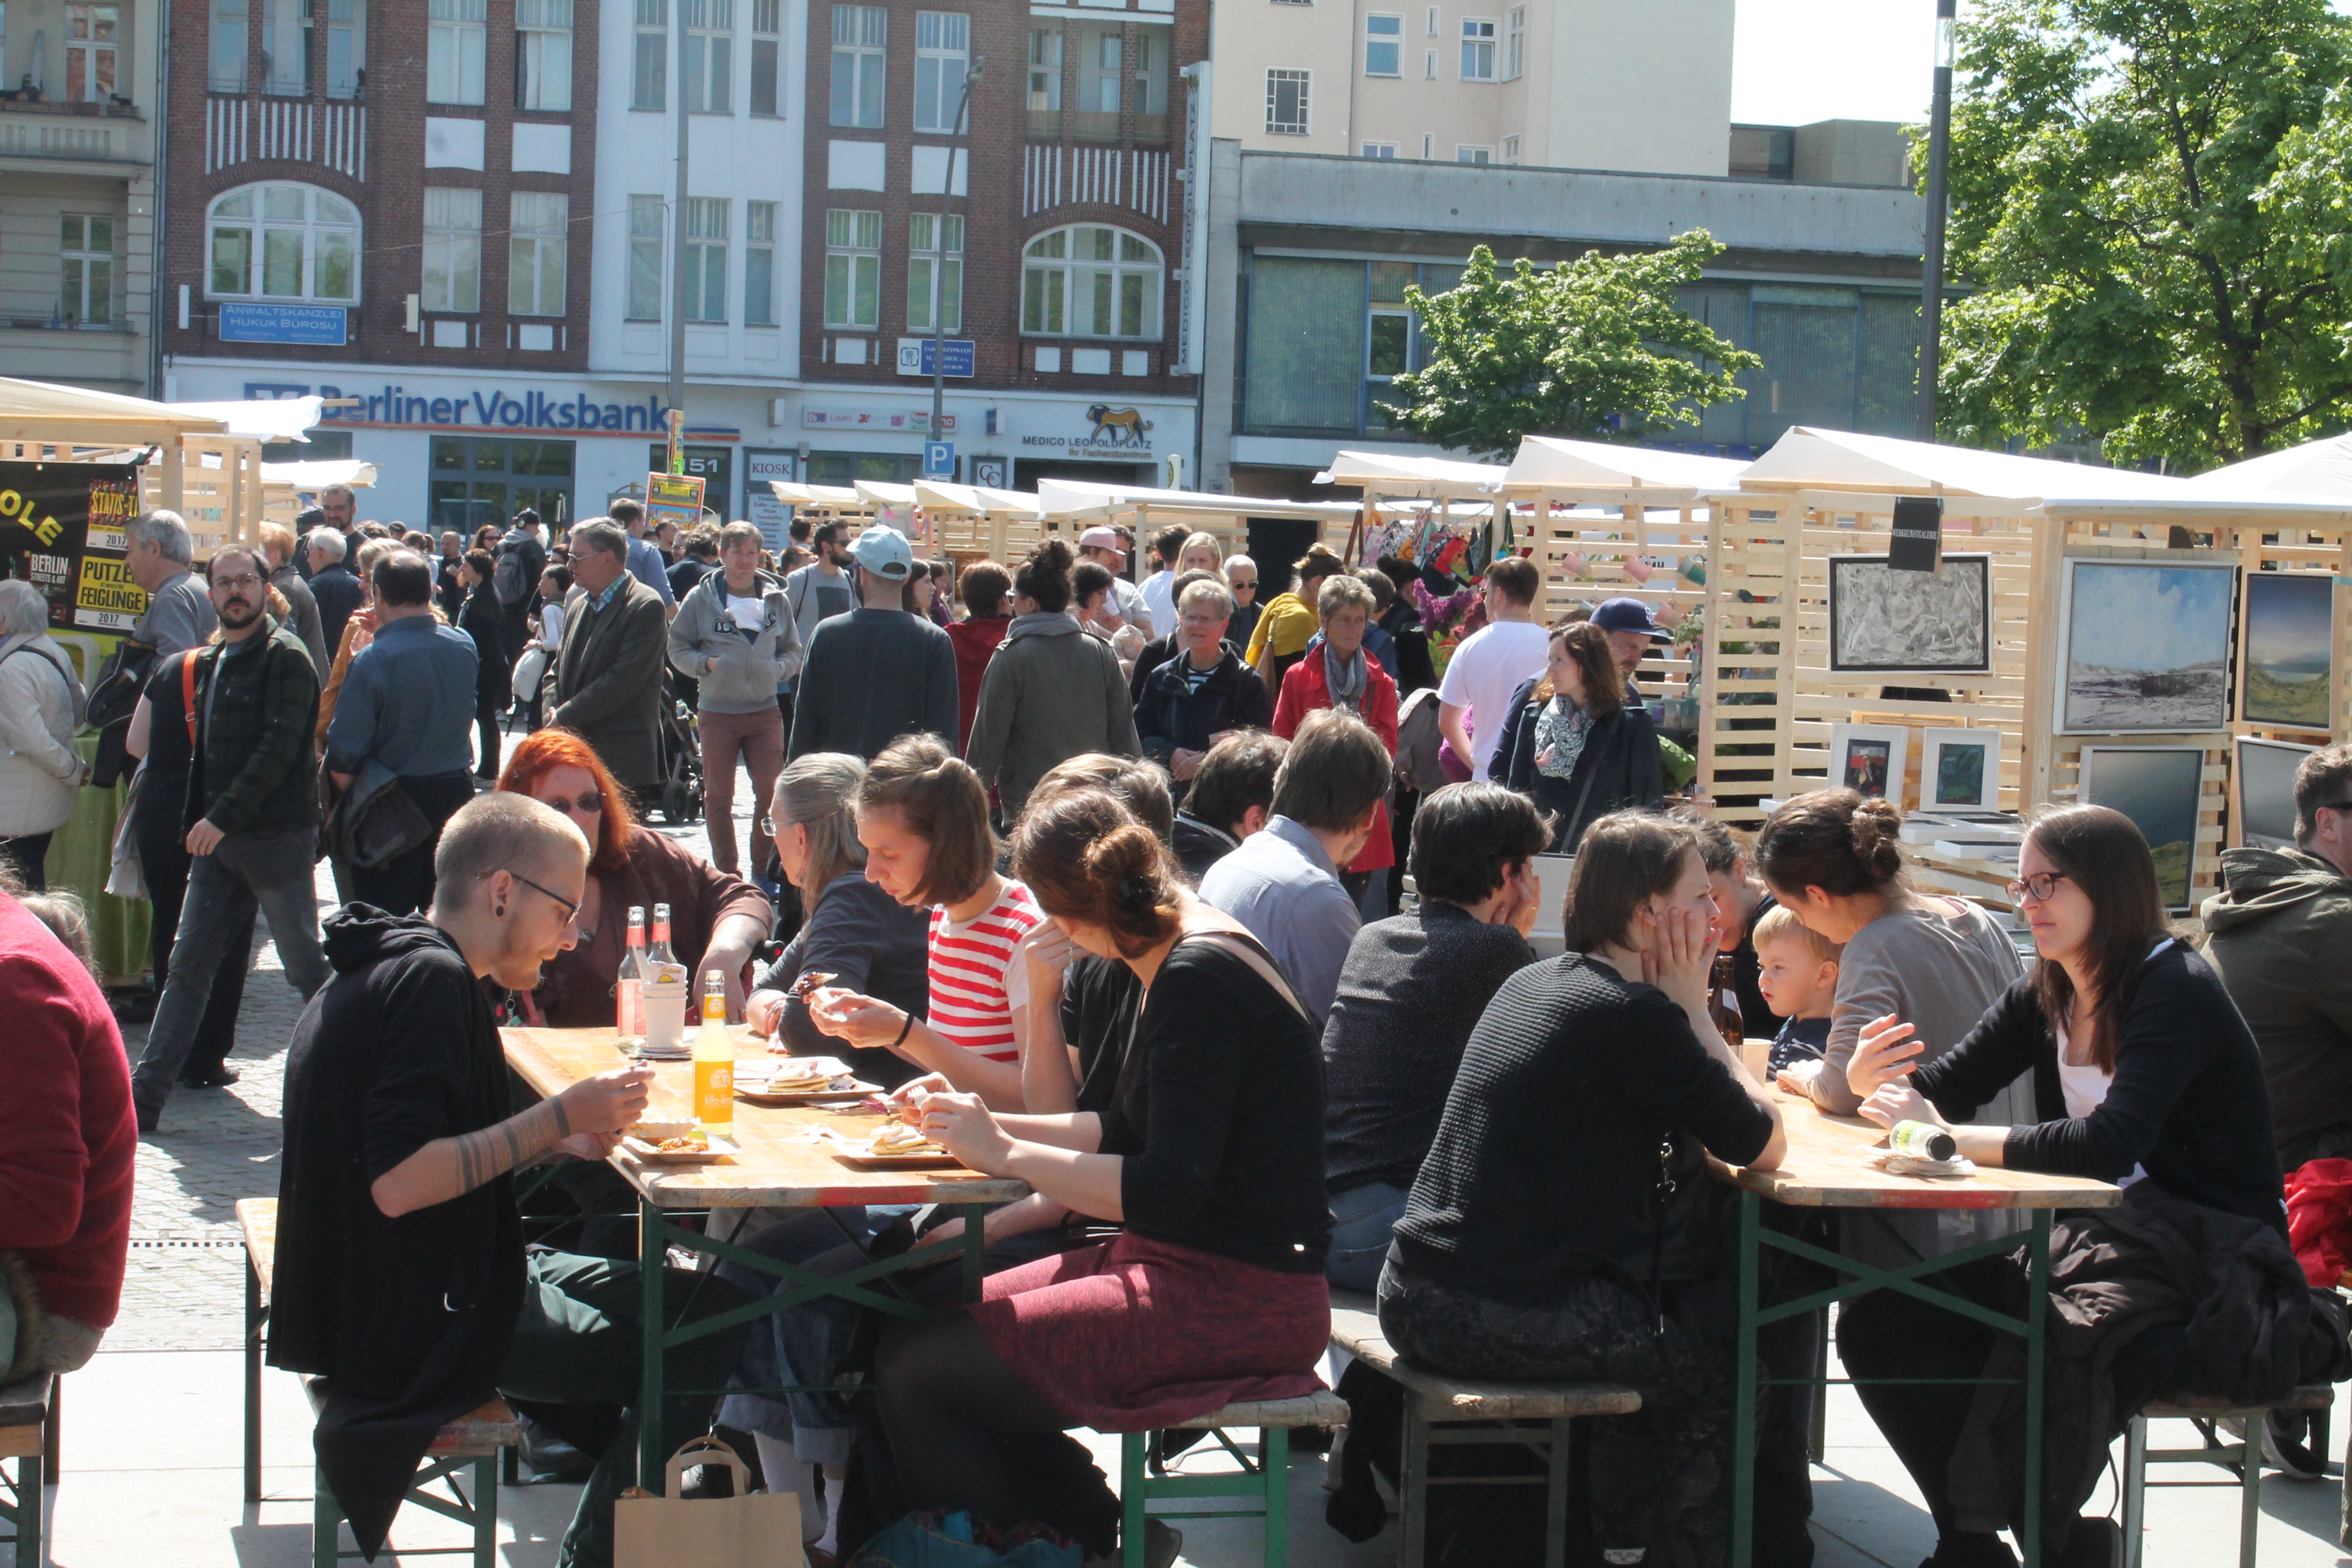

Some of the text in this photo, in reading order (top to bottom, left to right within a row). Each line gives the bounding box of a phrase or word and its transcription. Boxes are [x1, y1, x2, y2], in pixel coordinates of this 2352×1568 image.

[1185, 103, 1196, 270] LEOPOLDPLATZ
[225, 306, 341, 318] ANWALTSKANZLEI
[230, 318, 277, 328] HUKUK
[320, 385, 669, 431] Berliner Volksbank
[1022, 436, 1151, 449] MEDICO LEOPOLDPLATZ
[932, 445, 948, 470] P
[1083, 449, 1151, 459] Facharztzentrum
[752, 463, 791, 474] KIOSK
[107, 535, 127, 545] 2017
[31, 553, 69, 575] BERLIN
[84, 562, 134, 584] PUTZE
[81, 587, 142, 610] FEIGLINGE
[99, 613, 119, 623] 2017
